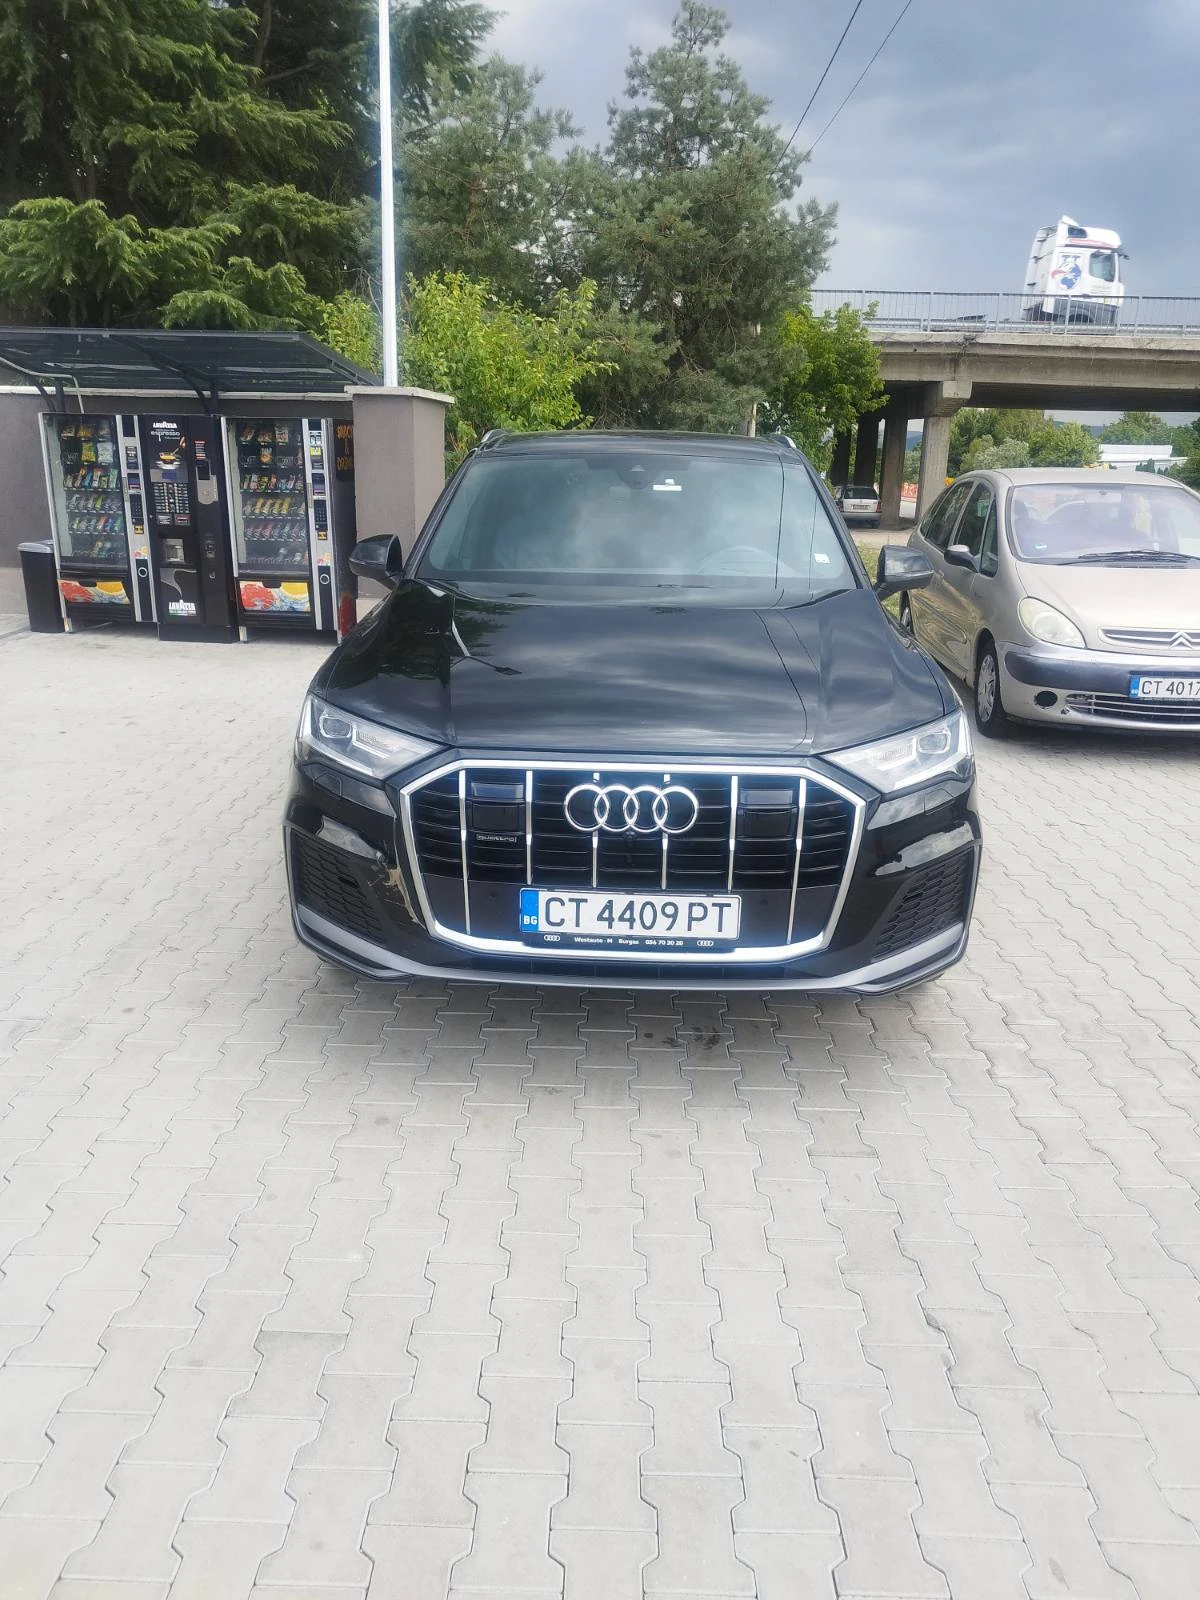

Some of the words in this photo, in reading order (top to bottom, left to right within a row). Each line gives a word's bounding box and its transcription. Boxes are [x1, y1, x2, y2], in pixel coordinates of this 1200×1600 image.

[152, 421, 178, 429] LAVAZZA
[1141, 680, 1163, 695] CT
[545, 897, 588, 927] CT
[596, 899, 679, 931] 4409
[687, 902, 732, 932] PT
[523, 916, 538, 925] BG
[618, 938, 639, 946] Burgas
